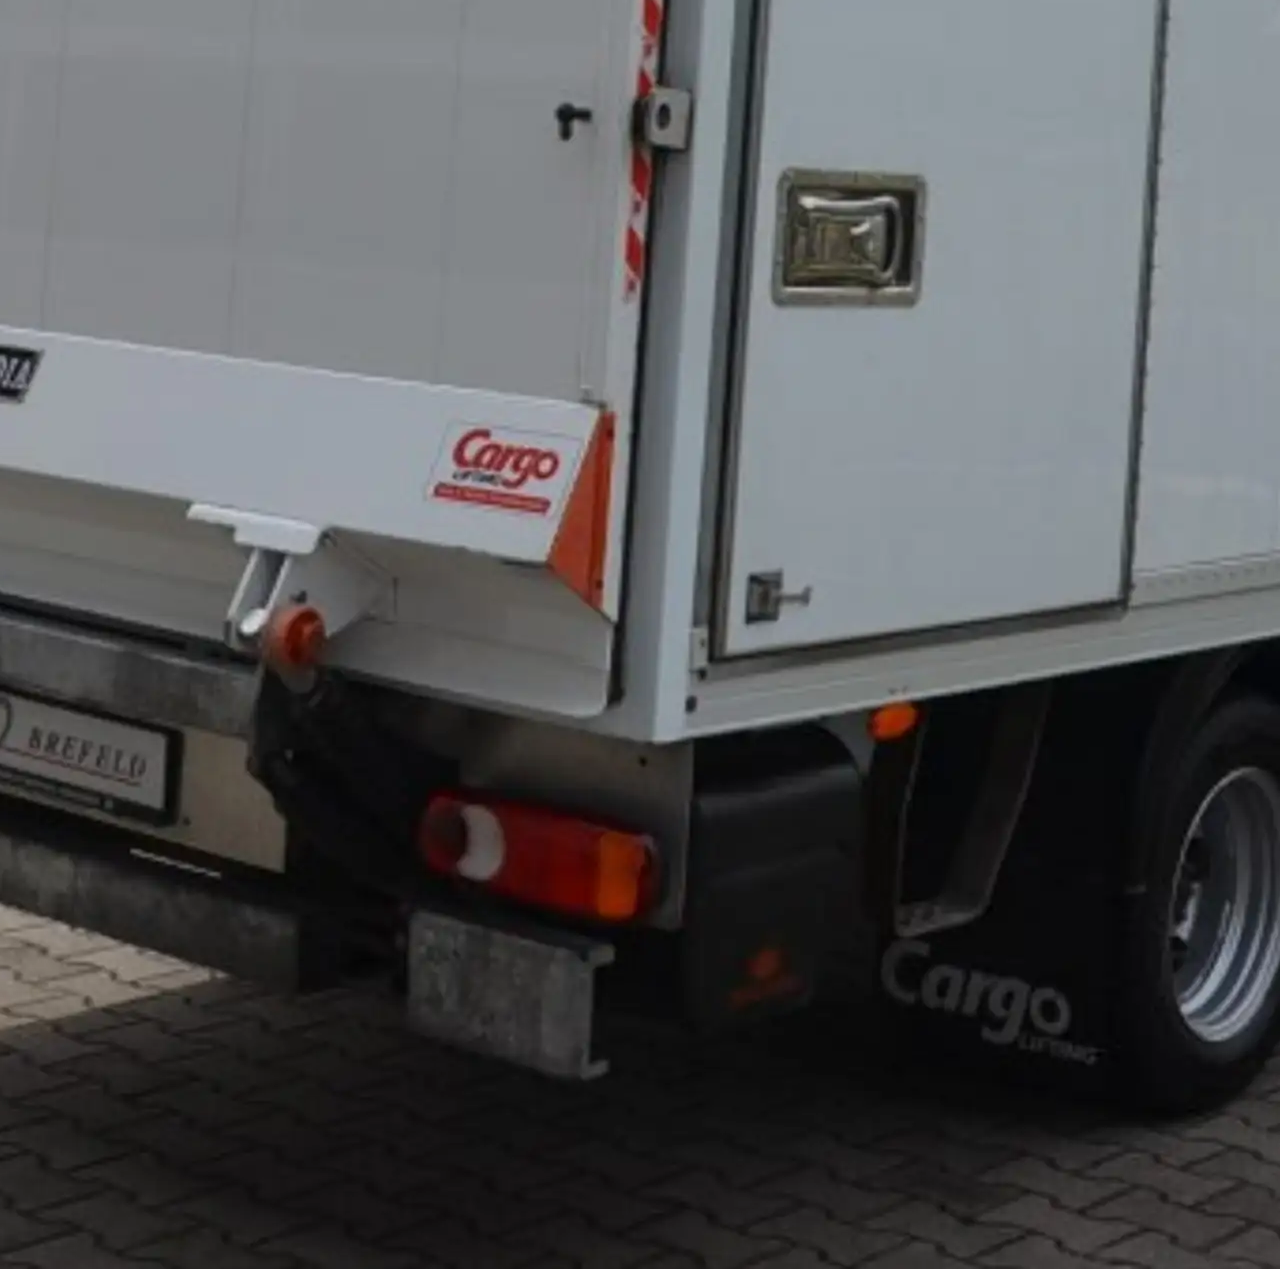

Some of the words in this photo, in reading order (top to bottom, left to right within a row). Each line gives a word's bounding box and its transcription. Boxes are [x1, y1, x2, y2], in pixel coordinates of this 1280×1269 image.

[452, 428, 560, 489] Cargo
[28, 726, 148, 779] BREFELD
[880, 936, 1072, 1045] Cargo
